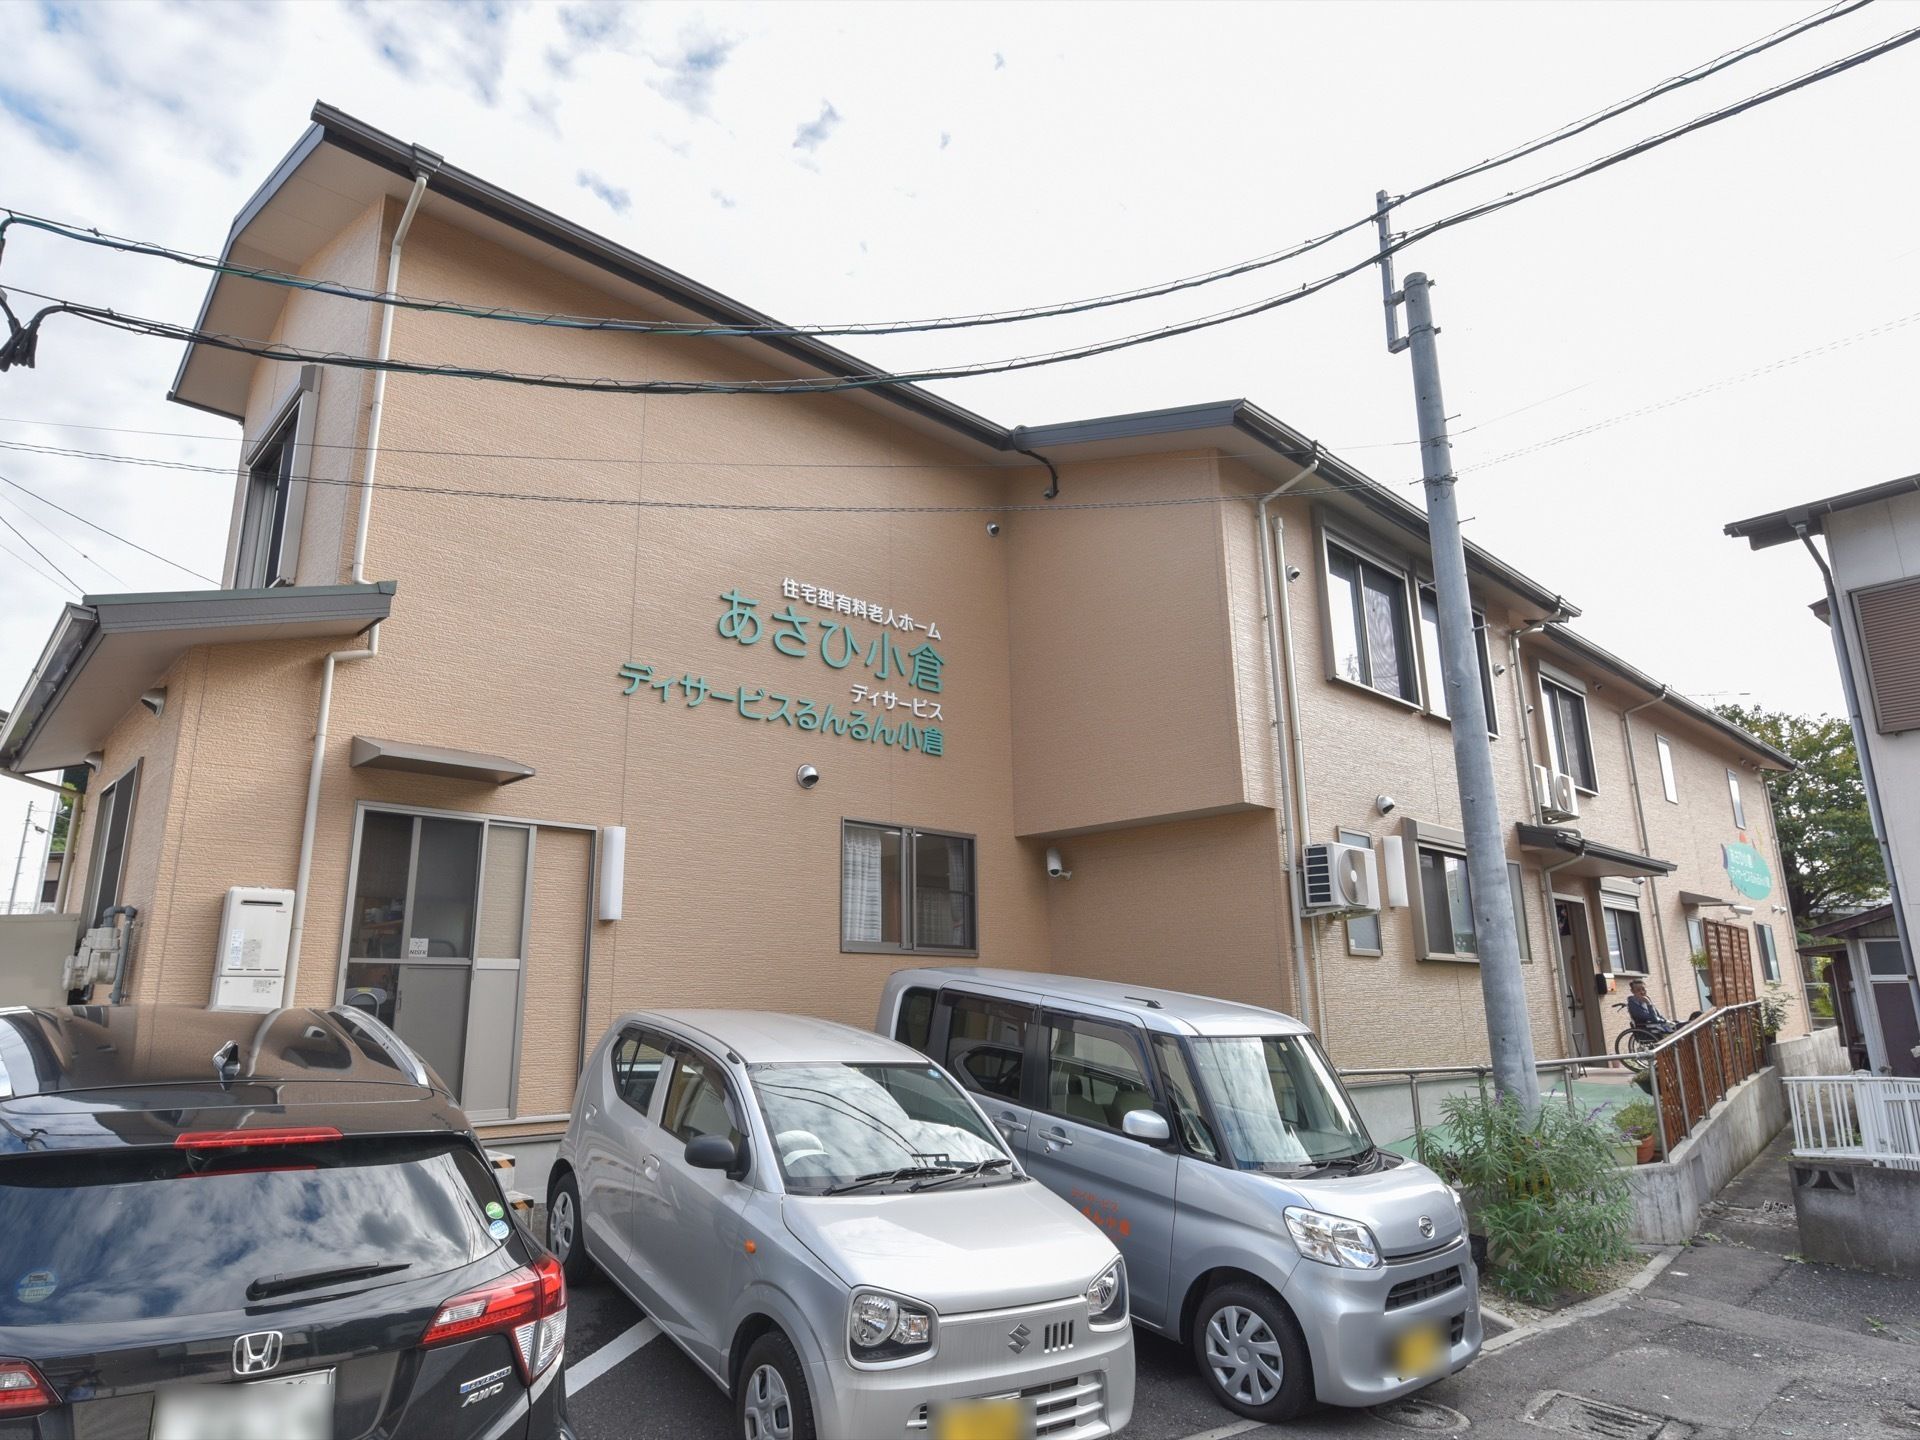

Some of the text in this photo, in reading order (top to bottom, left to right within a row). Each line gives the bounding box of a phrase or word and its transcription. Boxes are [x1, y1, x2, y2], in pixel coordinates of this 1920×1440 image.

[718, 587, 946, 693] あさひ小倉
[782, 577, 942, 641] 住宅型有料老人ホーム
[461, 1382, 504, 1408] AWD
